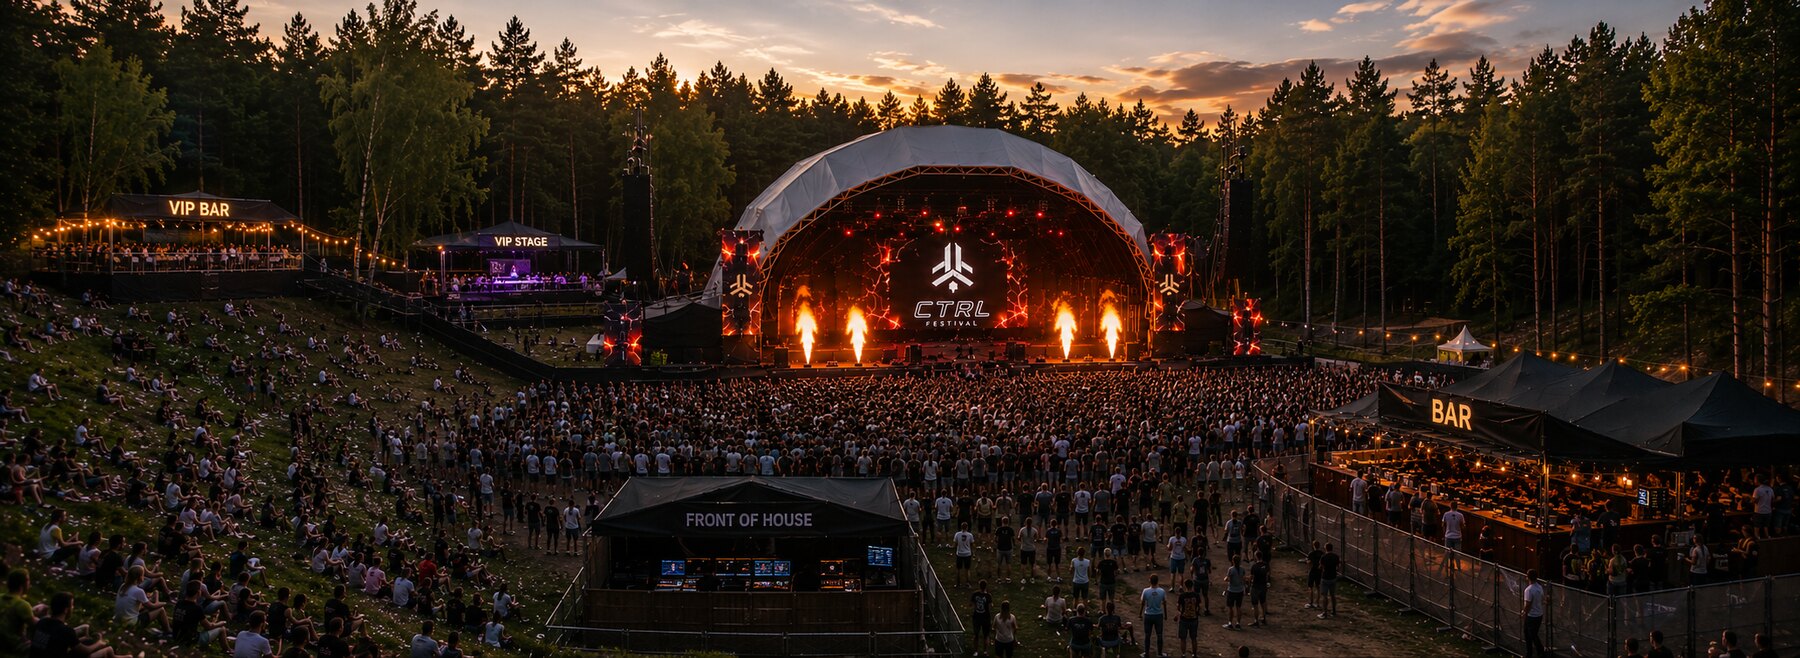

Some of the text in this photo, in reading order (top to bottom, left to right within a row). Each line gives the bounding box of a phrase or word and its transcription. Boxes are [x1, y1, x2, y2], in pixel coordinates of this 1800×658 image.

[168, 200, 230, 218] VIP BAR
[494, 237, 548, 247] VIP STAGE
[914, 300, 990, 319] CTRL
[925, 320, 978, 328] FESTIVAL
[1431, 398, 1472, 431] BAR
[686, 513, 813, 527] FRONT OF HOUSE
